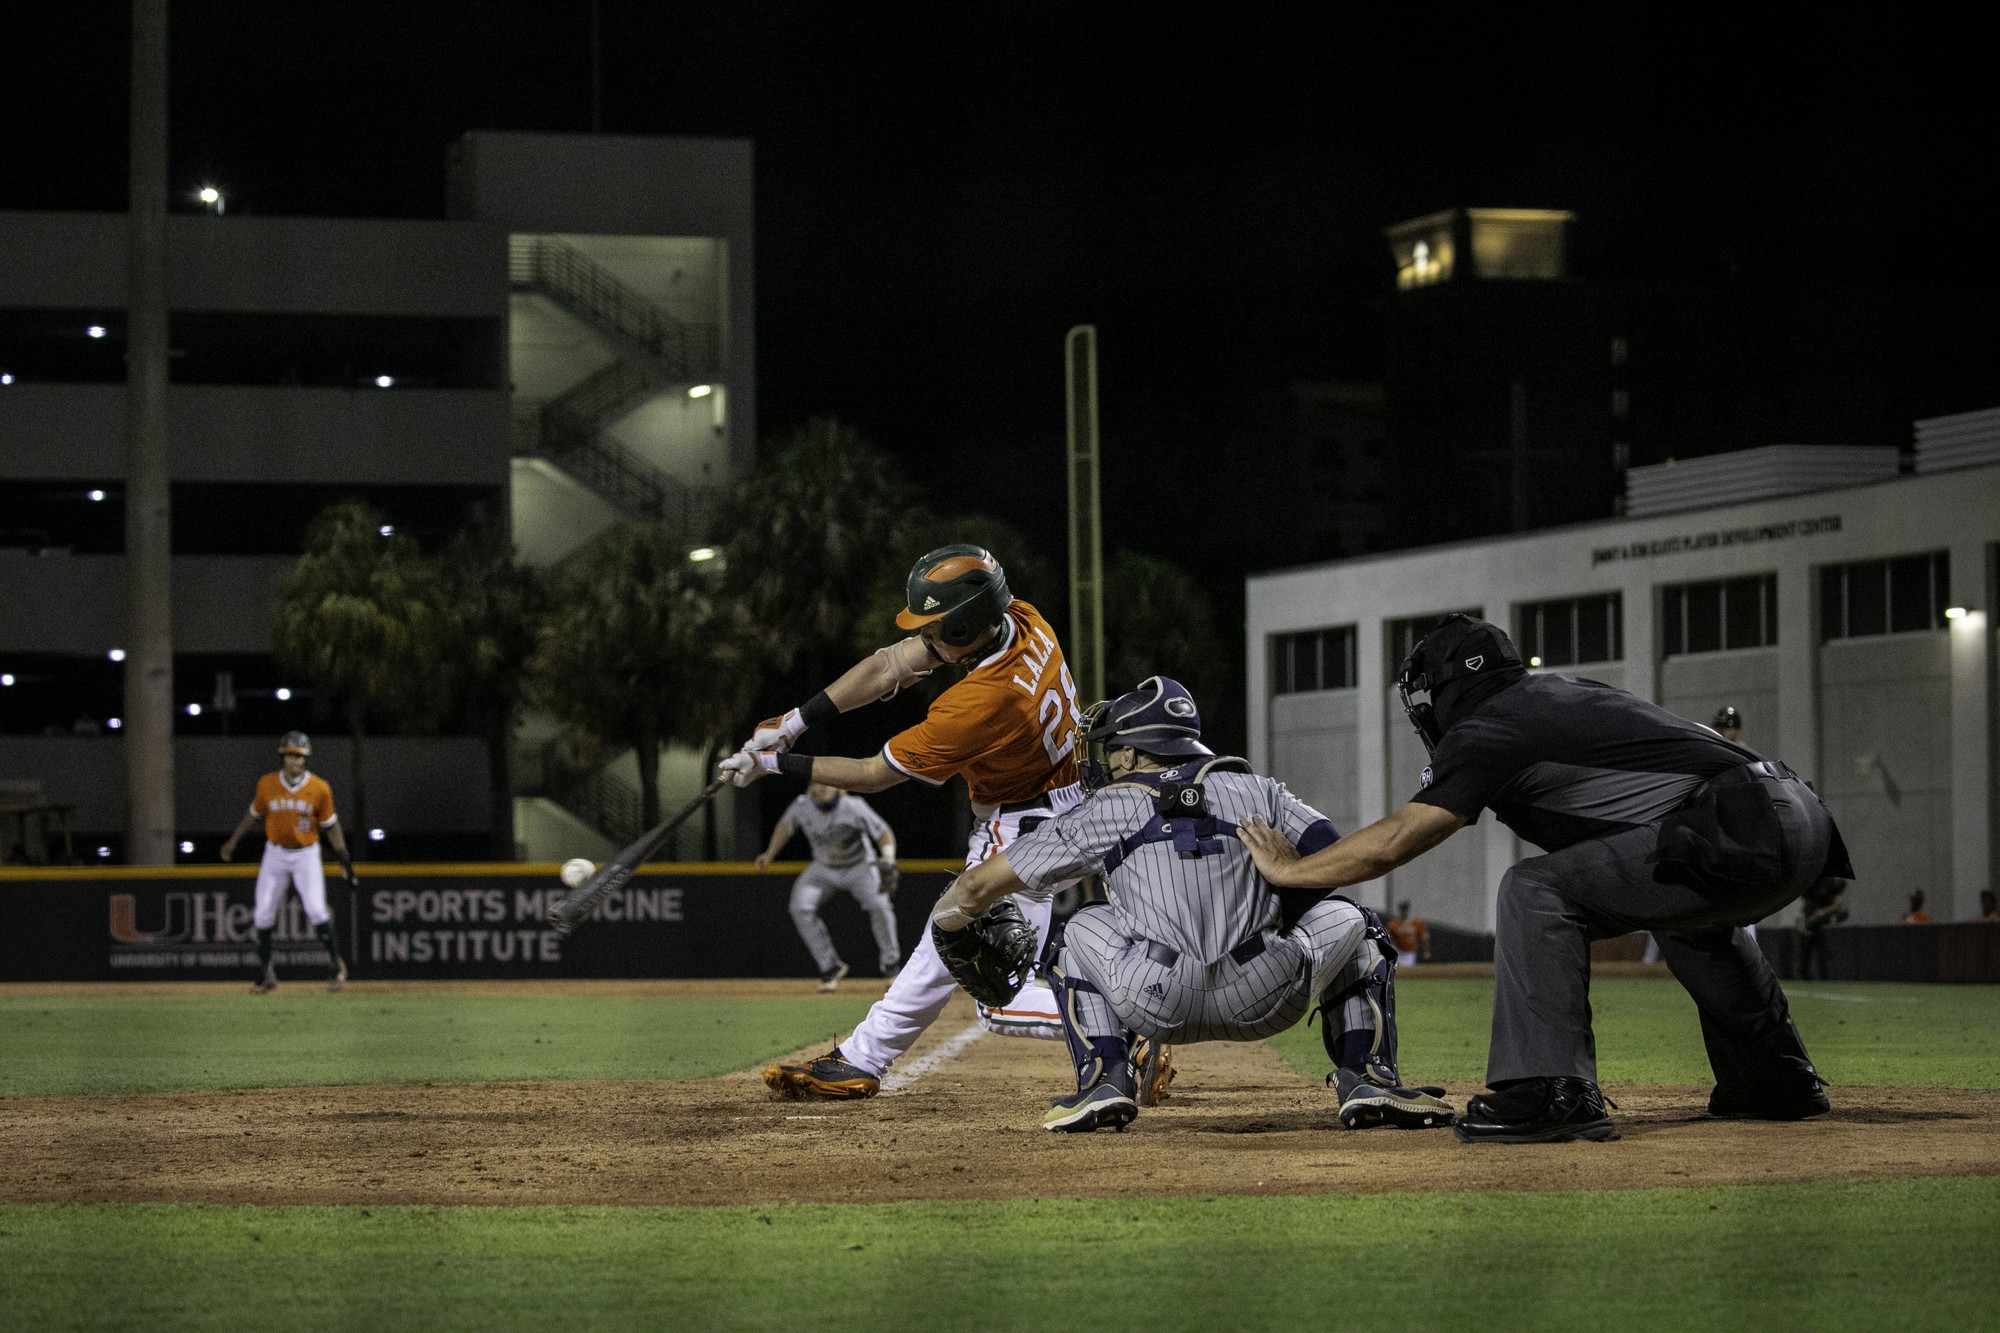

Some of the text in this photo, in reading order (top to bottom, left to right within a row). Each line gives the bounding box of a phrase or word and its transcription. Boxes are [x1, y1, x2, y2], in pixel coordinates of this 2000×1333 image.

[1013, 626, 1055, 696] LALA
[372, 888, 685, 922] SPORTS MECINE
[372, 931, 561, 962] INSTITUTE
